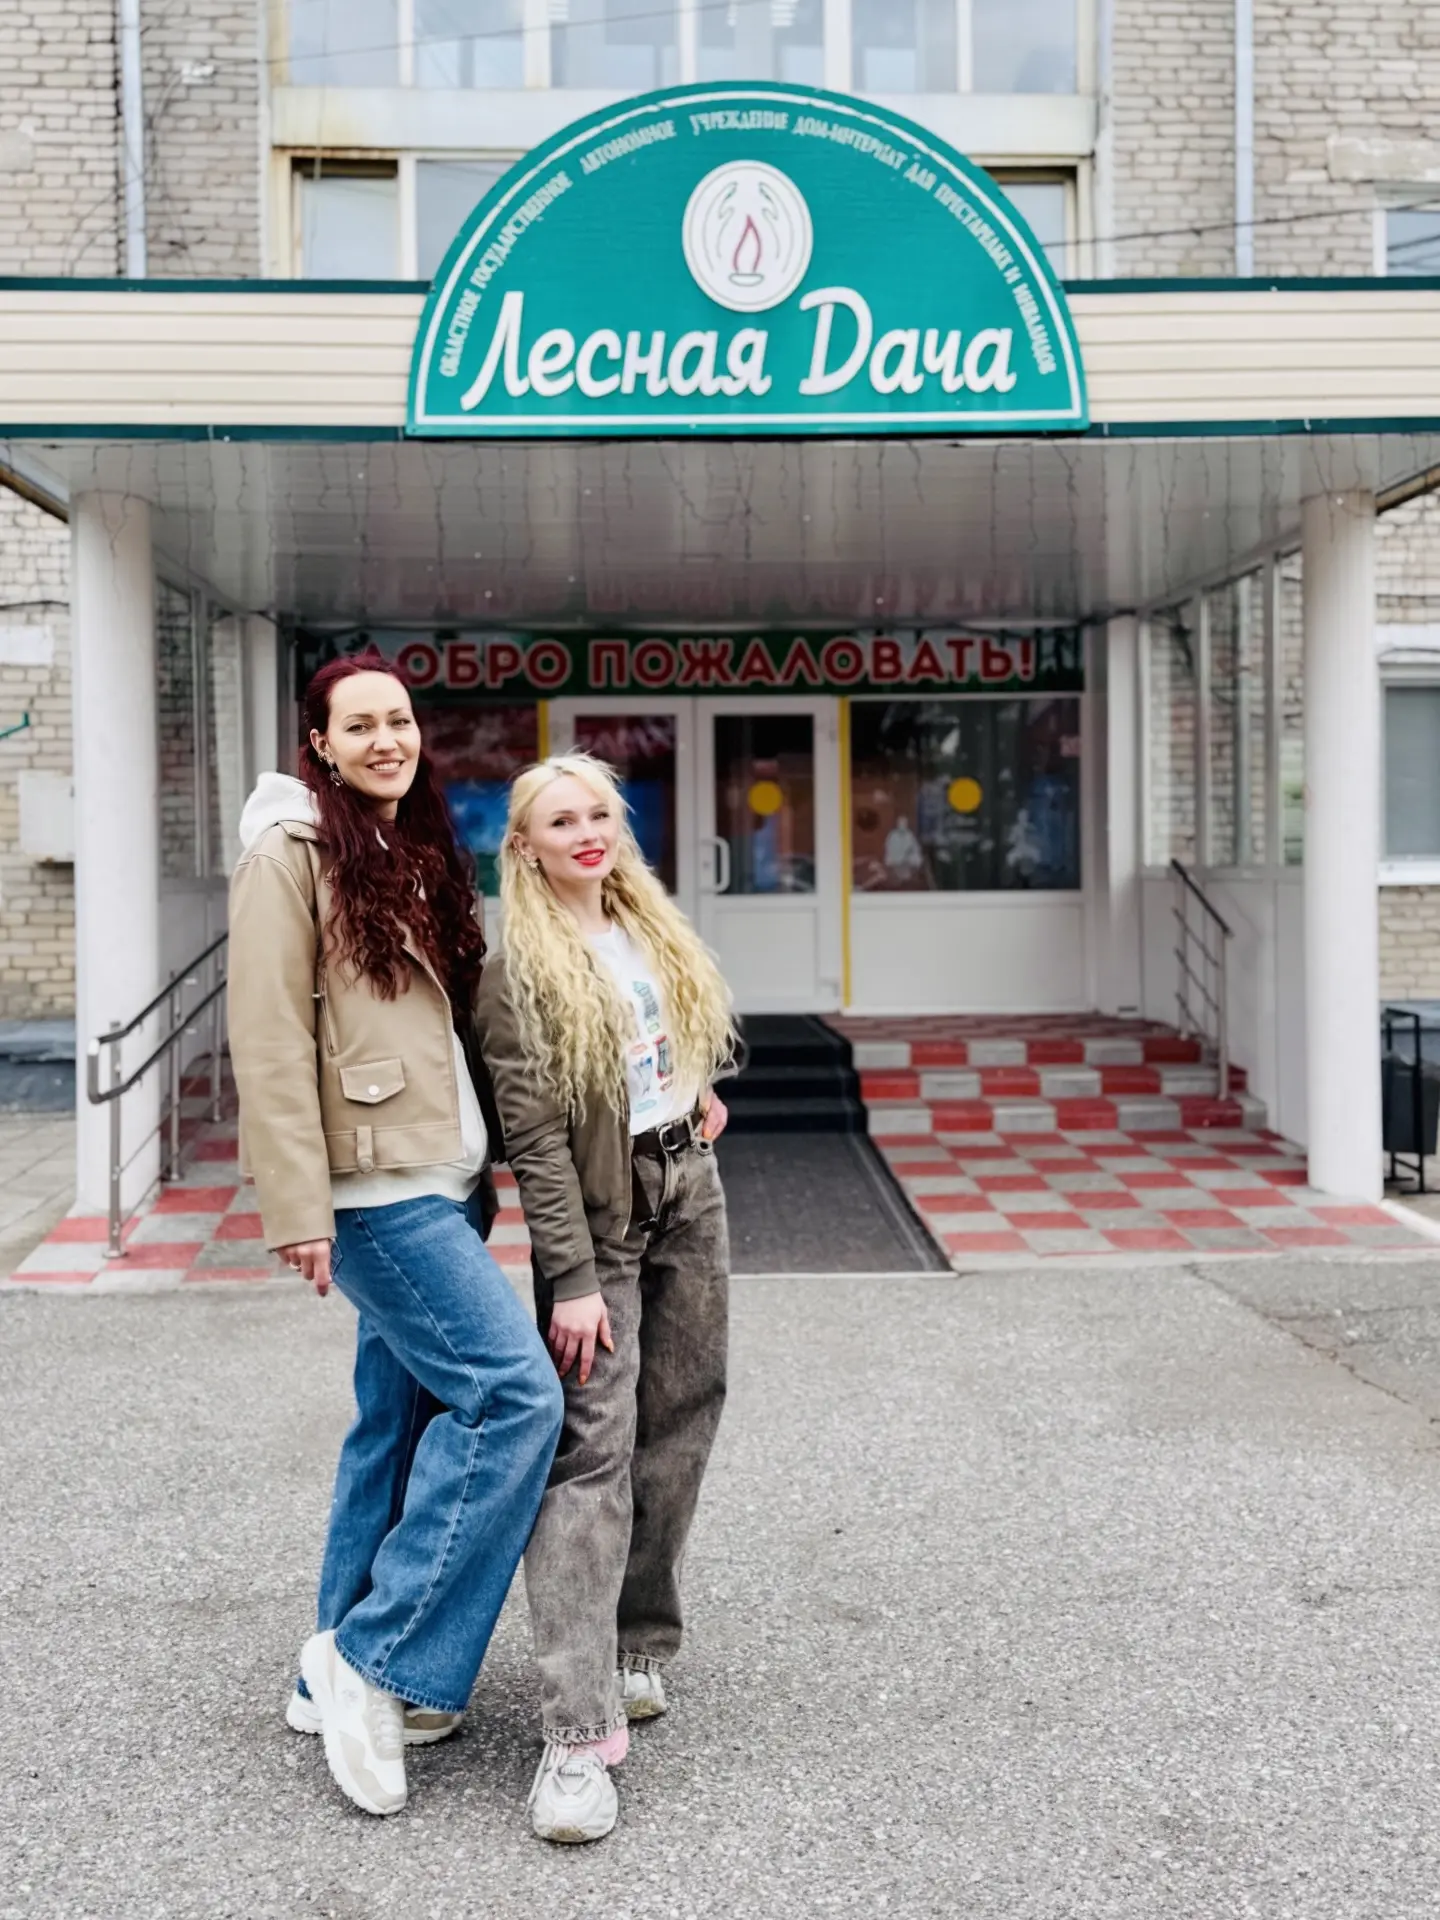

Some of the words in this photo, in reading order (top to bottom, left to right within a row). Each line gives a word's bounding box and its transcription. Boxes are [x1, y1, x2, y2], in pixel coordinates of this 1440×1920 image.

[460, 291, 772, 411] Лесная
[799, 286, 1017, 395] Дача
[364, 640, 572, 688] ОБРО
[589, 637, 1036, 688] ПОЖАЛОВАТЬ!
